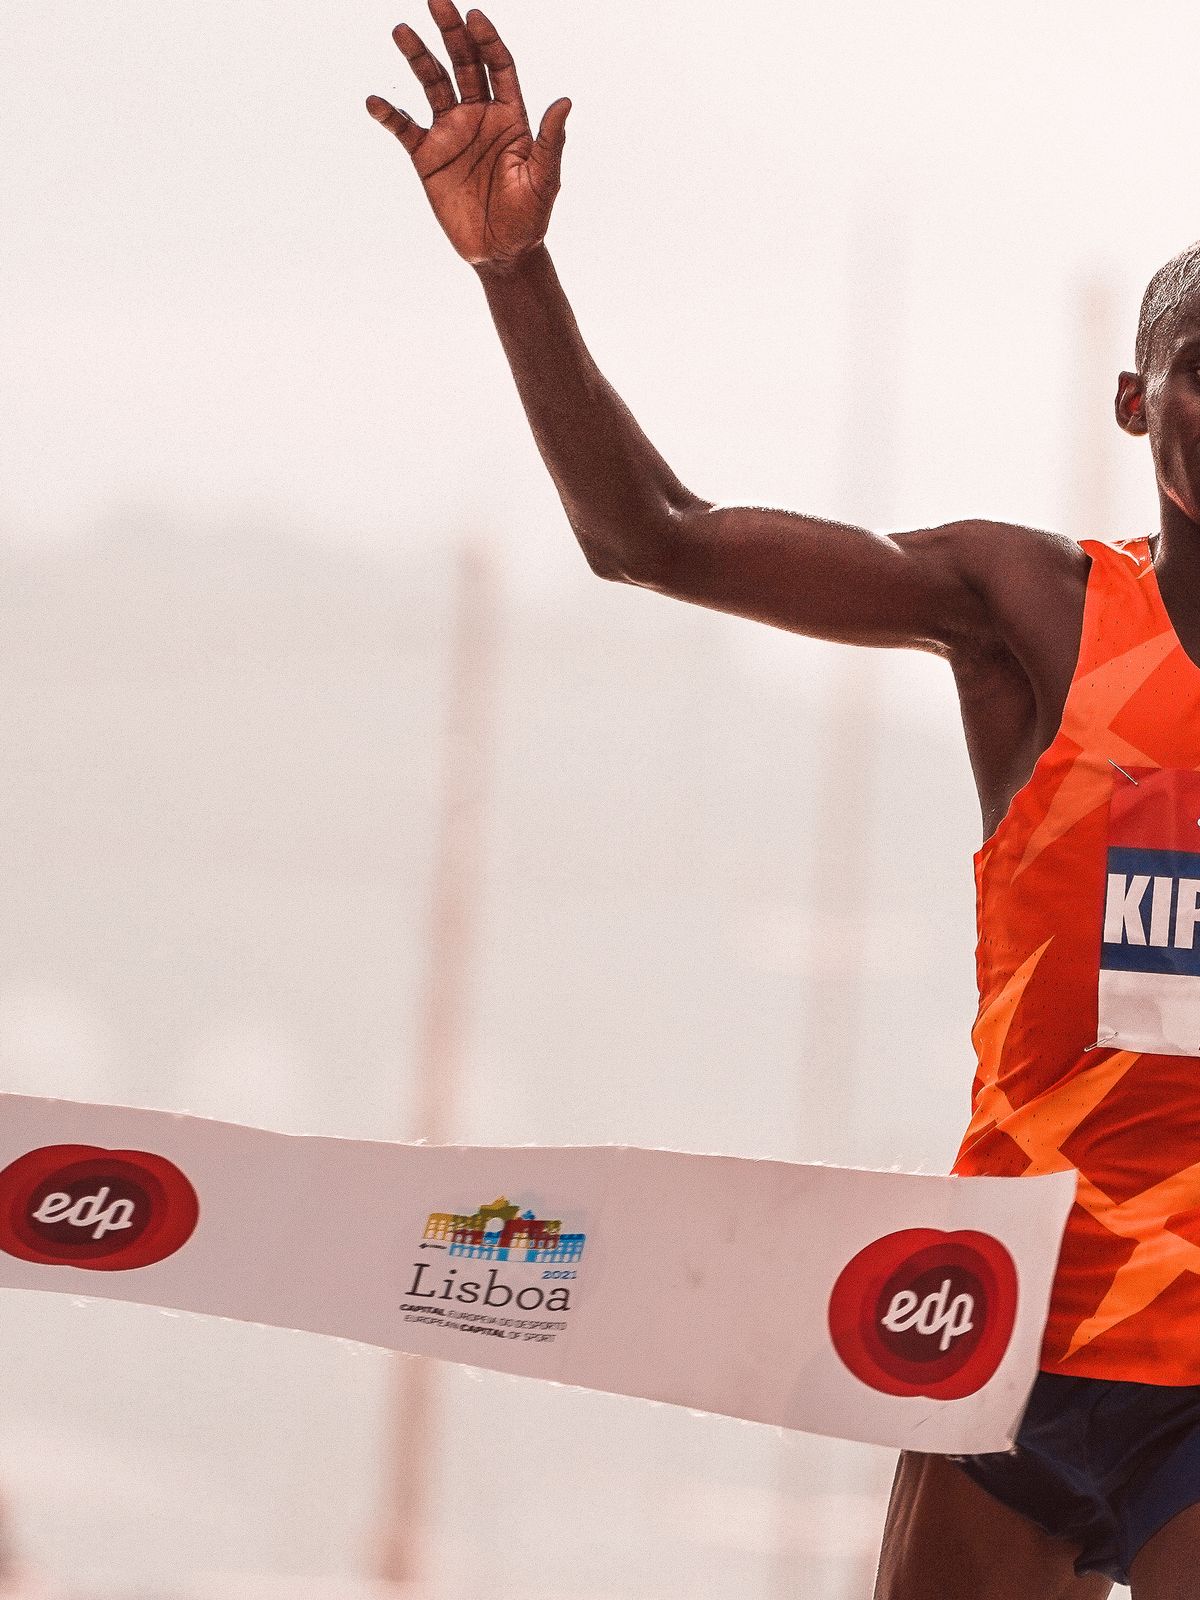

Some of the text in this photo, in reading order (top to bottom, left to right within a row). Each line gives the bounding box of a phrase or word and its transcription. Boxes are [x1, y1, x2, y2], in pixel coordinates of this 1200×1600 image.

[32, 1186, 135, 1240] edp
[404, 1262, 571, 1312] Lisboa
[541, 1270, 578, 1280] 2021
[399, 1303, 446, 1317] CAPITAL
[881, 1279, 975, 1351] edp
[459, 1323, 506, 1339] CAPITAL
